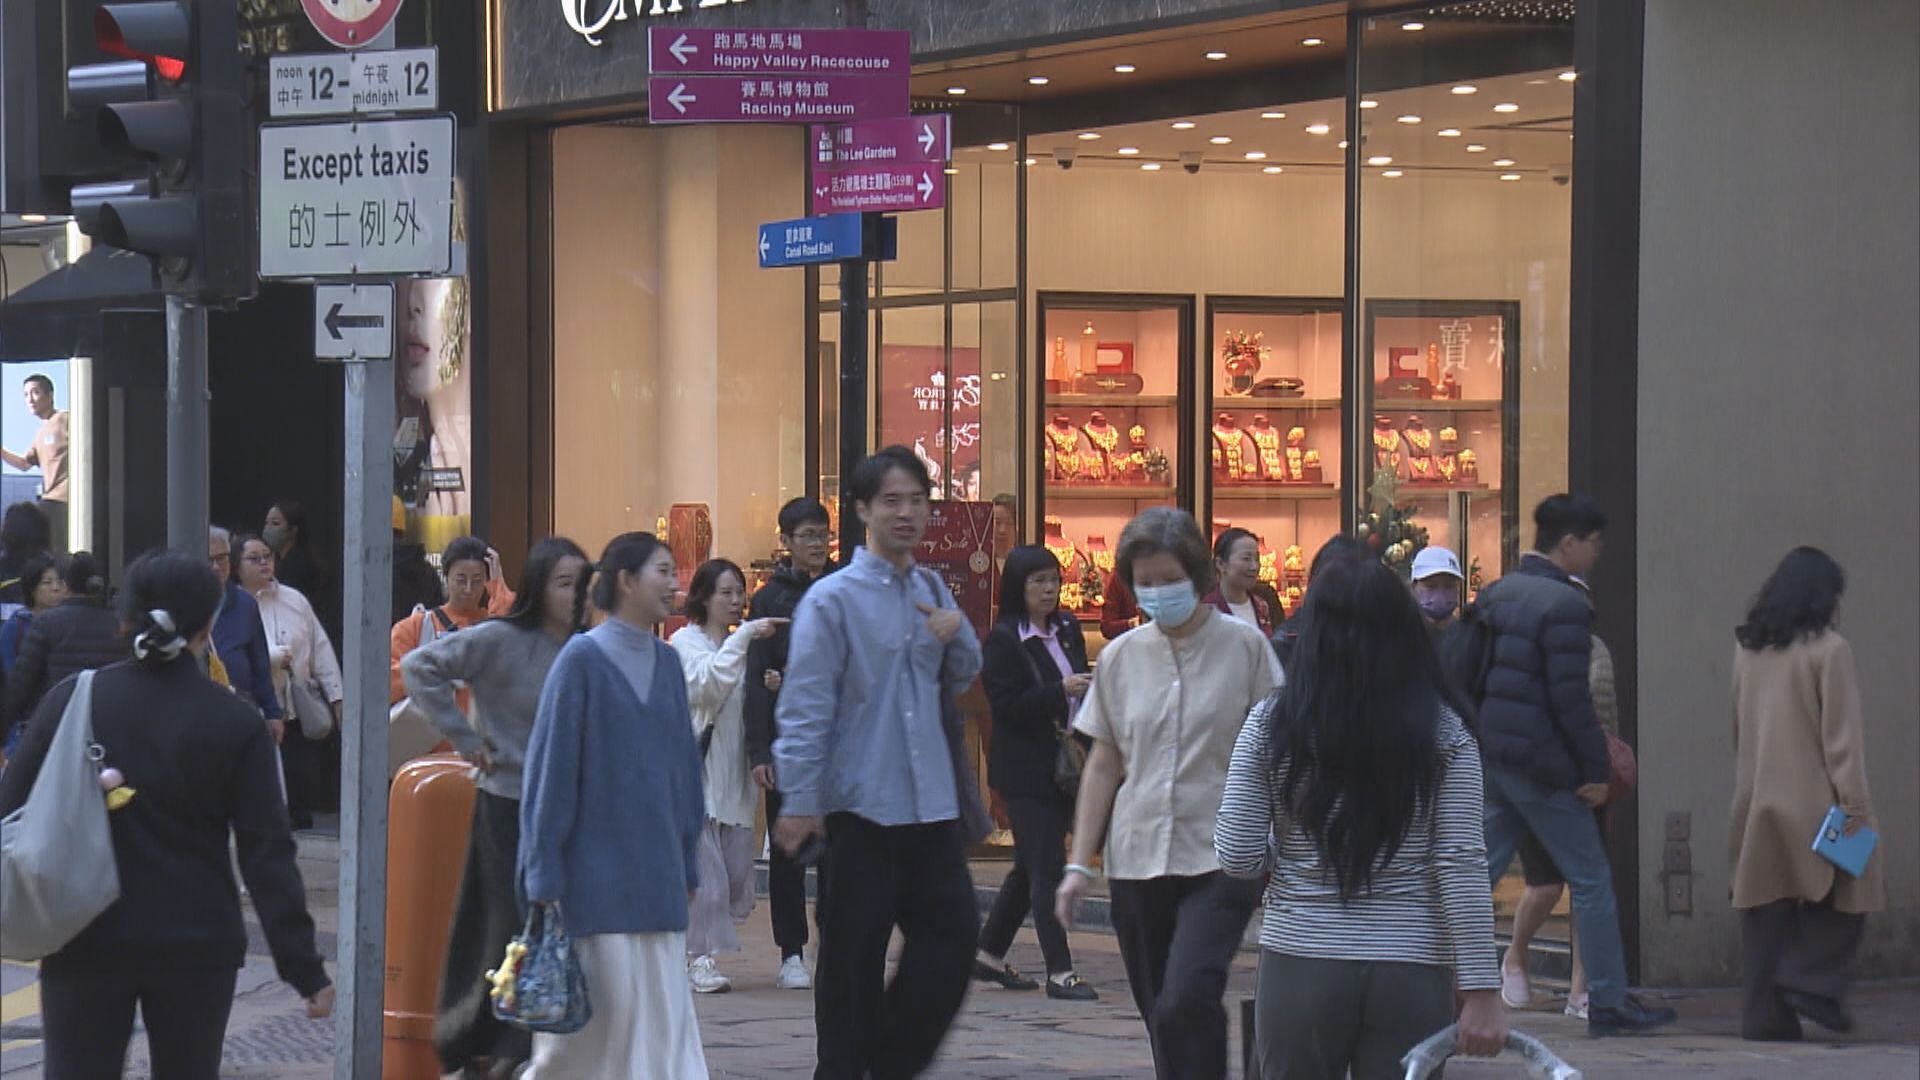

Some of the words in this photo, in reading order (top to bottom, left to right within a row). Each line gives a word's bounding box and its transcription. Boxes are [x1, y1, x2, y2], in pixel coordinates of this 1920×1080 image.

[714, 32, 802, 50] 跑馬地馬場
[713, 53, 759, 69] Happy
[763, 53, 807, 70] Valley
[811, 55, 890, 69] Racecouse
[277, 67, 303, 79] noon
[363, 64, 389, 85] 午夜
[404, 61, 429, 96] 12
[278, 88, 303, 108] 中午
[353, 89, 399, 106] midnight
[741, 80, 828, 98] 賽馬博物館
[741, 102, 791, 117] Racing
[795, 103, 855, 115] Museum
[864, 146, 897, 159] Gardens
[284, 145, 364, 186] Except
[370, 141, 429, 176] taxis
[289, 198, 421, 248] 的士例外
